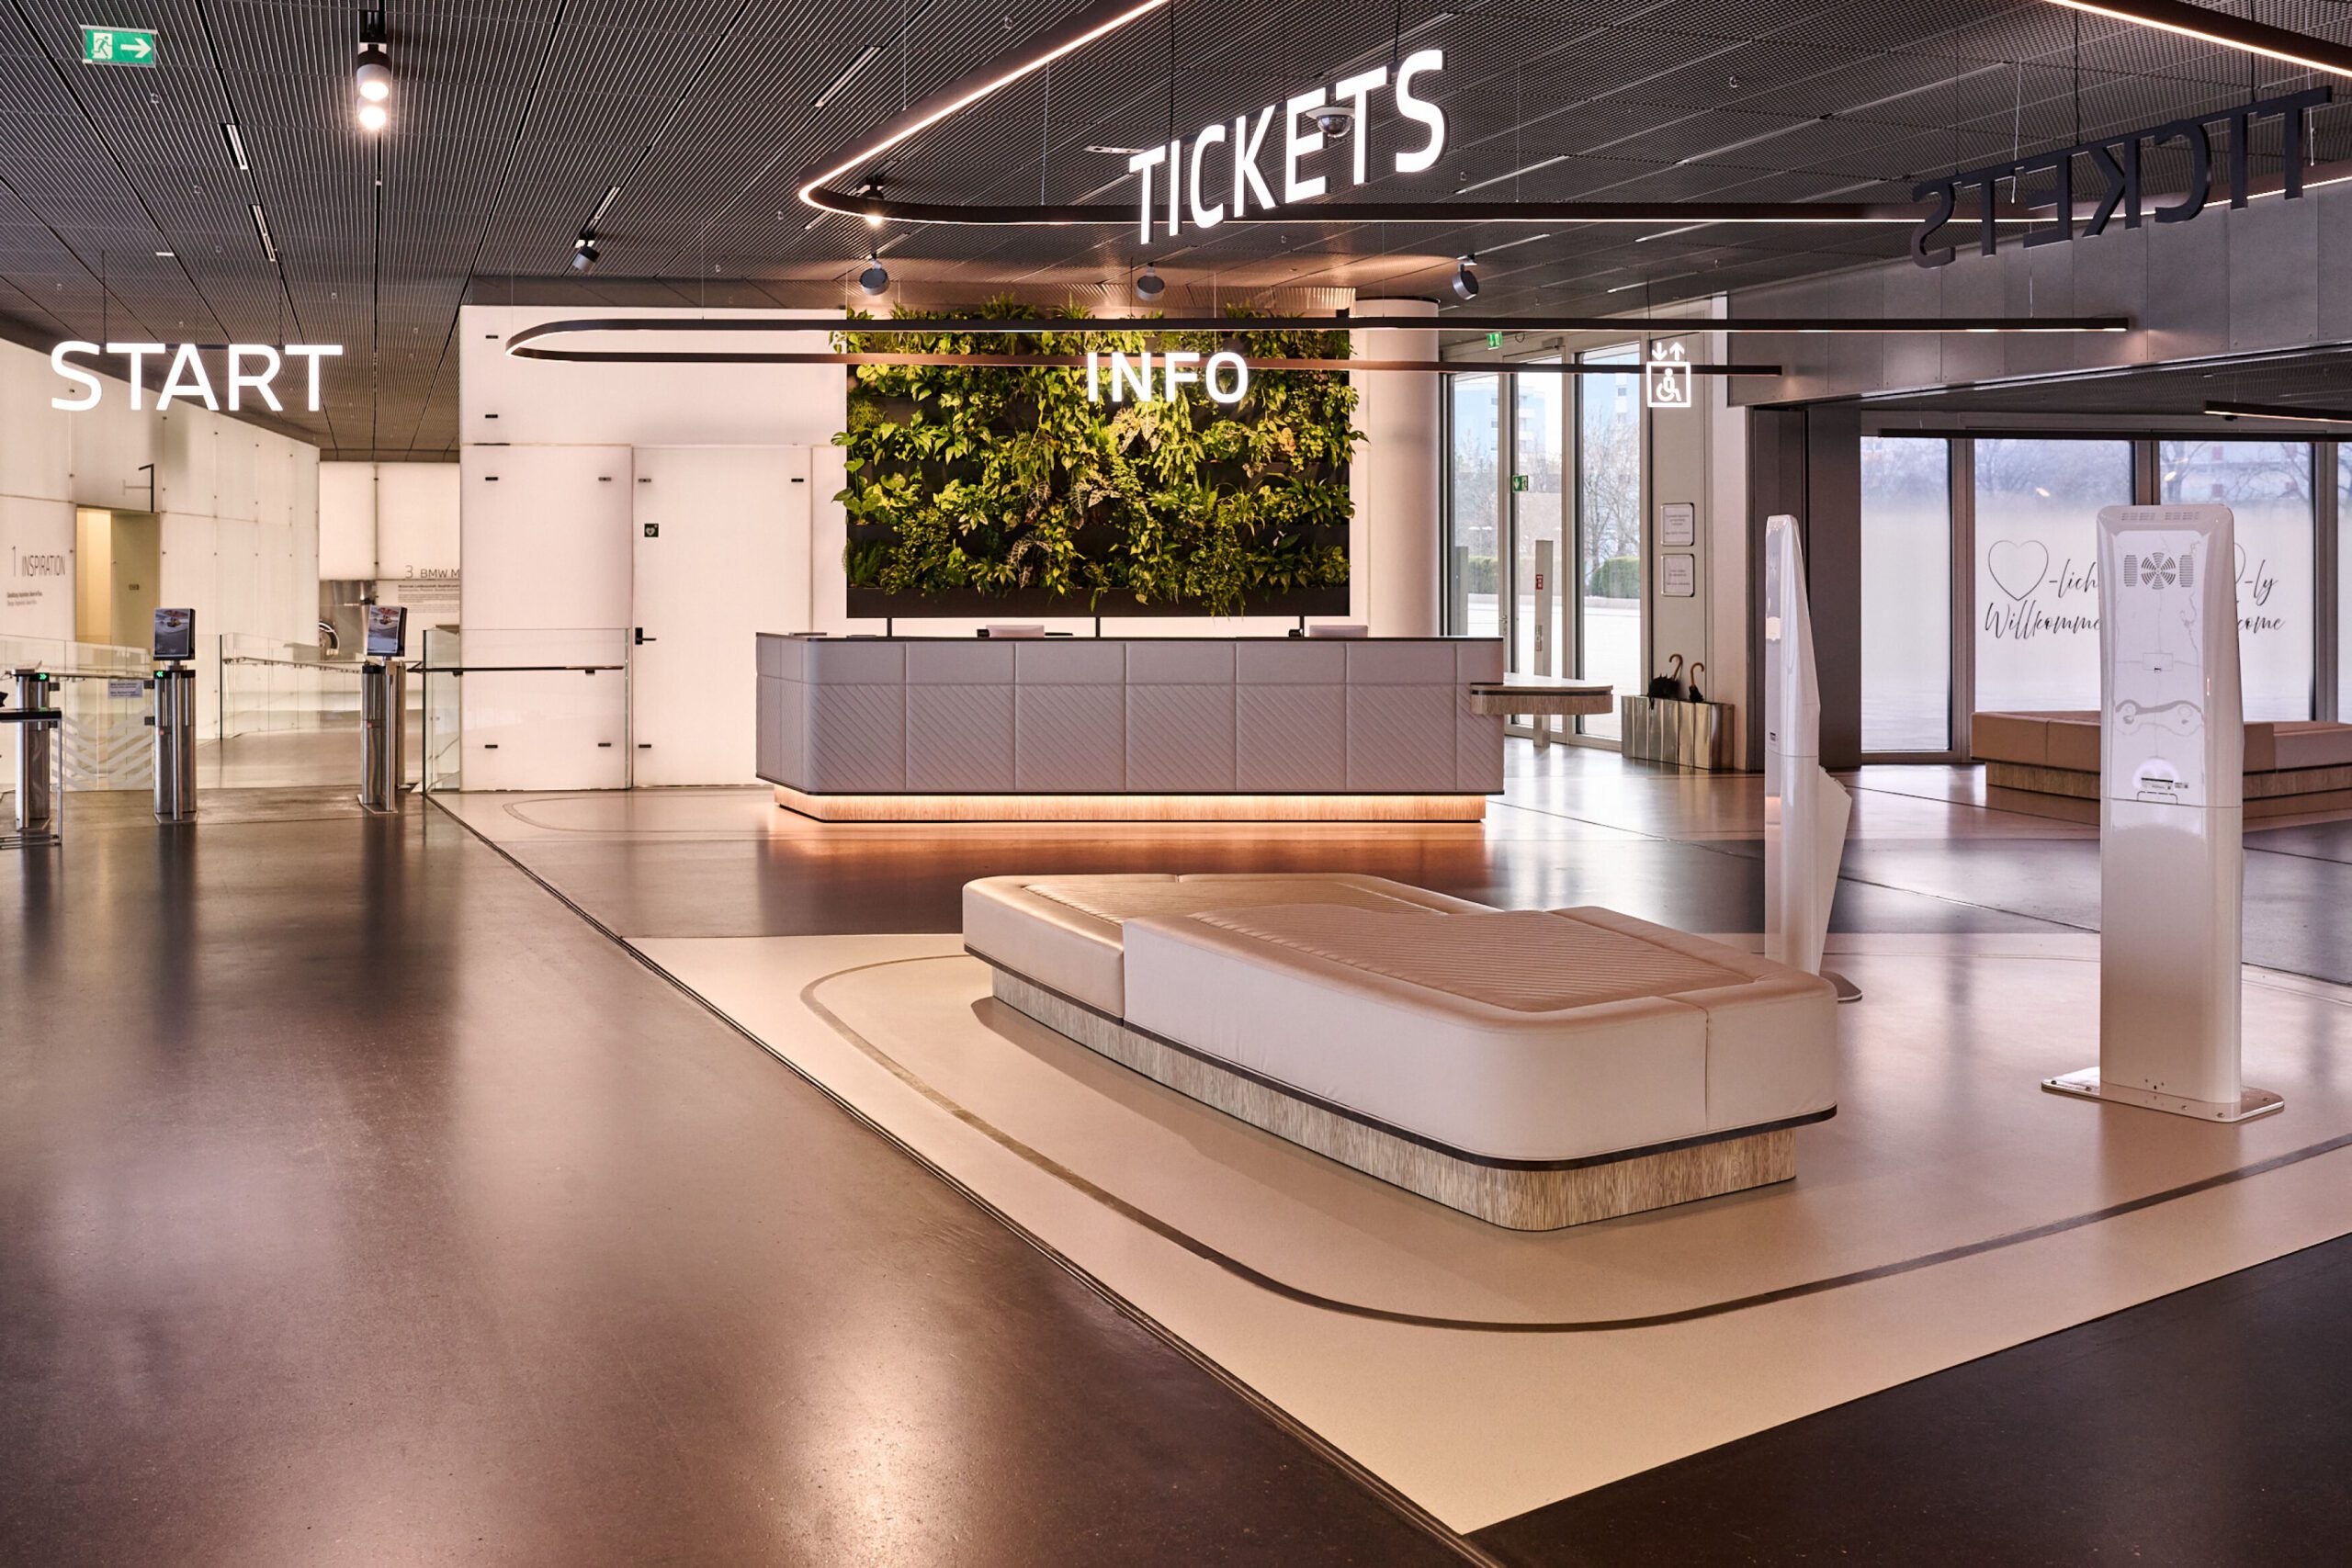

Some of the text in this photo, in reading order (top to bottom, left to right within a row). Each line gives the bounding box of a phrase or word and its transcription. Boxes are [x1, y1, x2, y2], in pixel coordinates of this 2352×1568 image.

[1128, 49, 1449, 245] TICKETS
[50, 340, 344, 412] START
[1086, 351, 1250, 404] INFO
[12, 546, 66, 577] 1 INSPIRATION
[404, 564, 414, 579] 3
[420, 569, 447, 579] BMW
[1984, 600, 2100, 640] Willkomme
